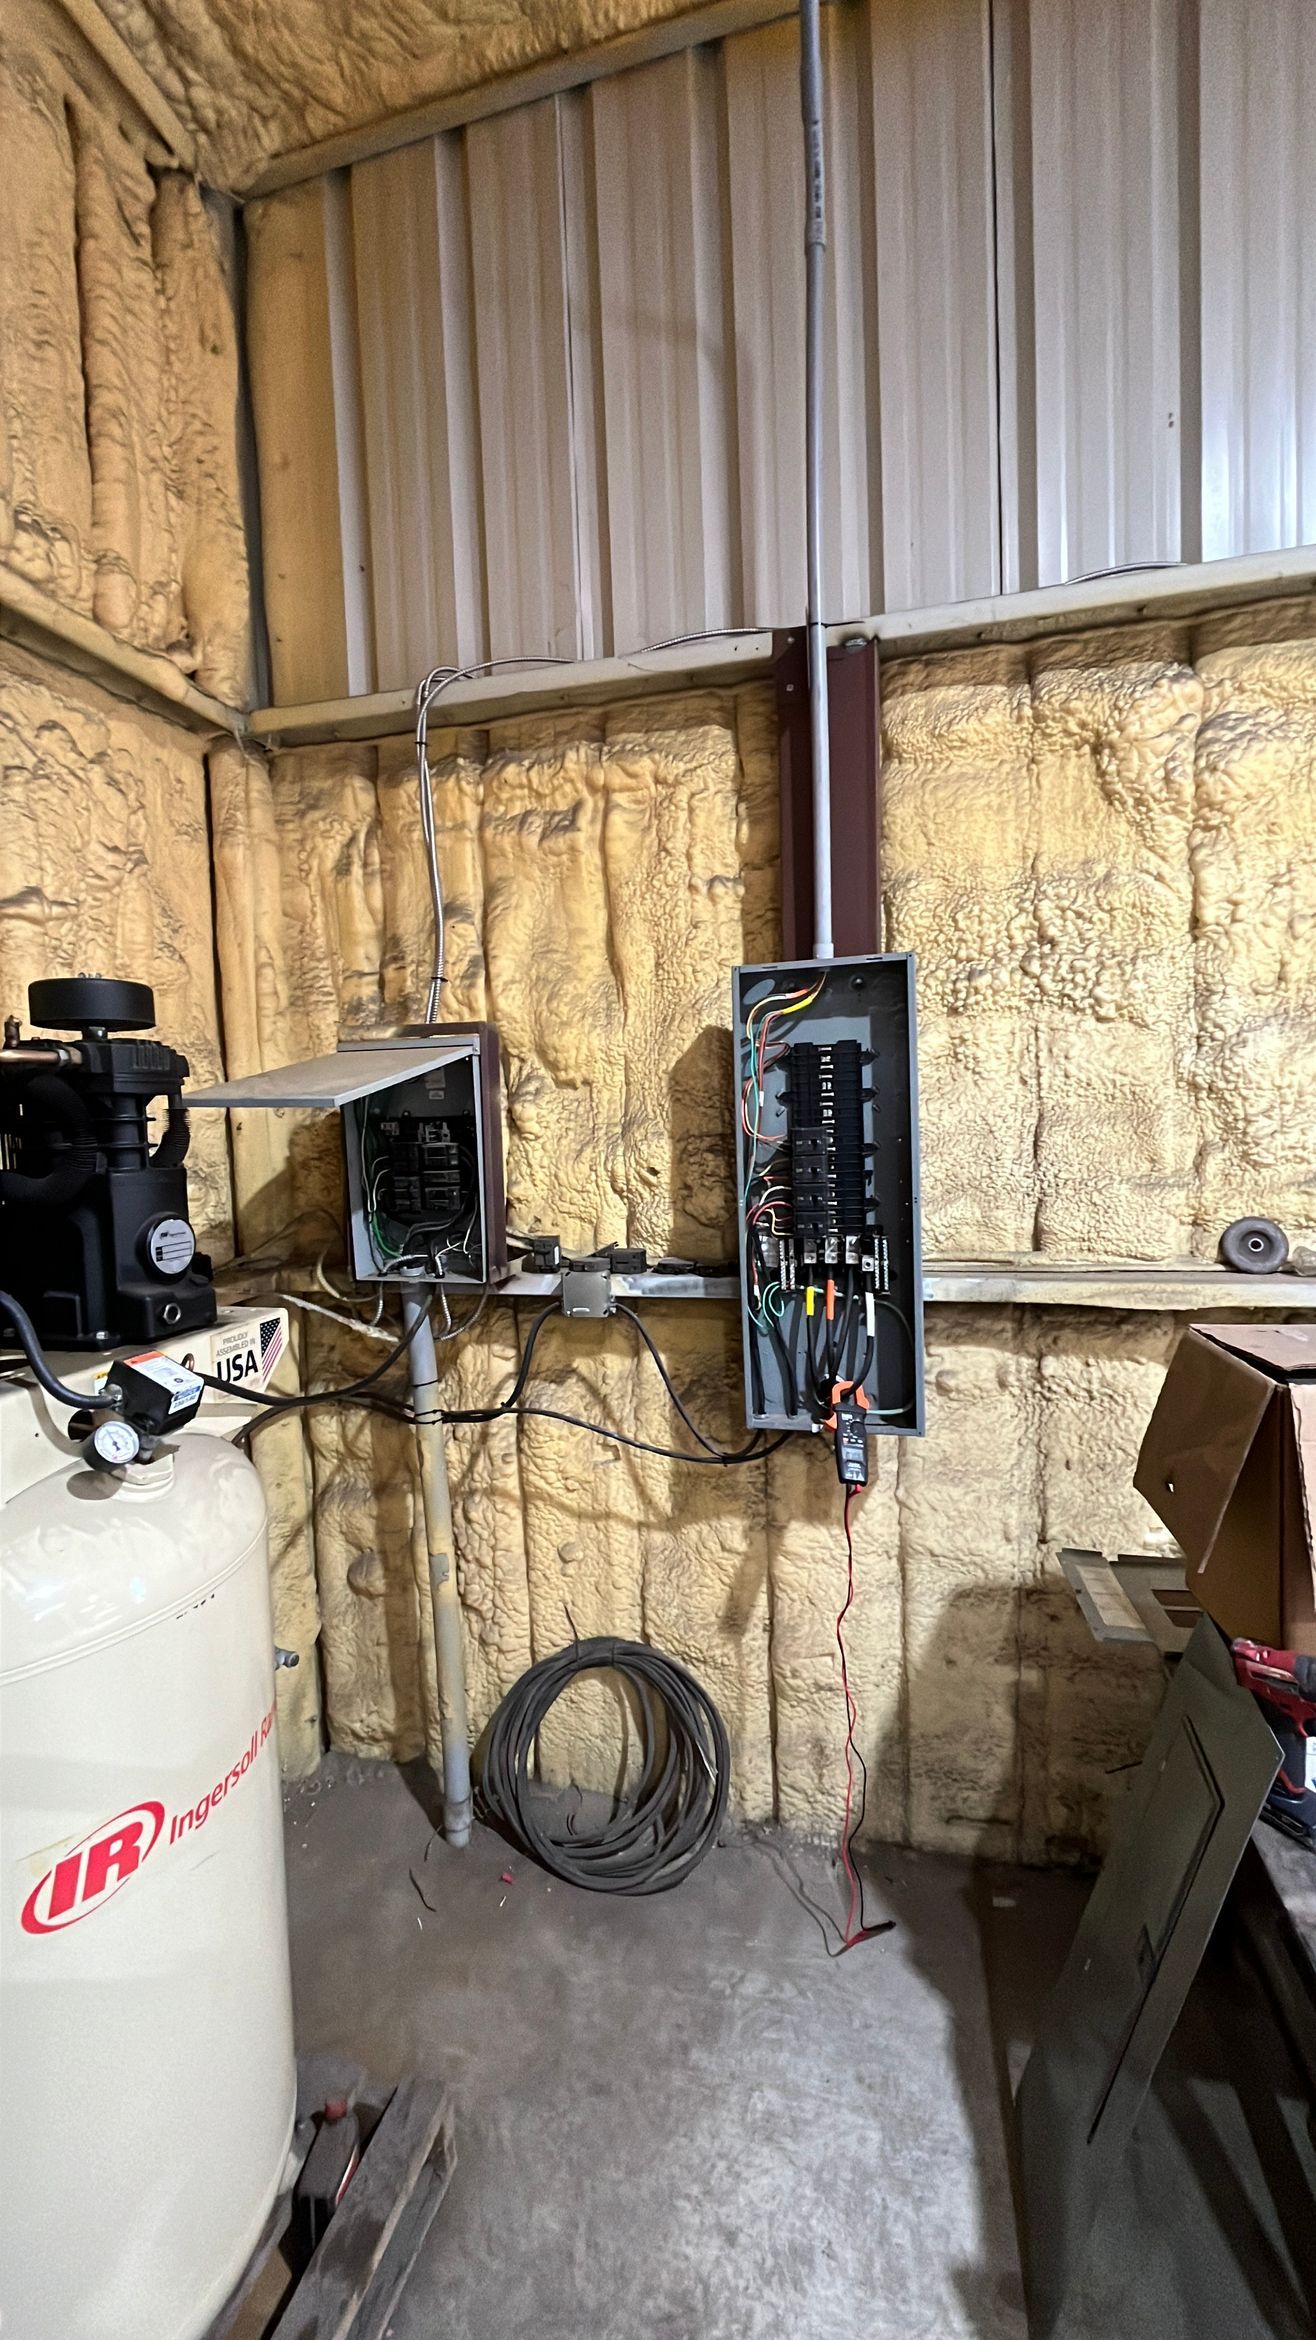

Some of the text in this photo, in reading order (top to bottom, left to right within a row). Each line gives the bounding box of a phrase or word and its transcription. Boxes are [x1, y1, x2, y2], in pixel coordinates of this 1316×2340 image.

[216, 1349, 259, 1383] USA
[47, 1821, 144, 1920] IR
[169, 1730, 258, 1845] Ingersoll
